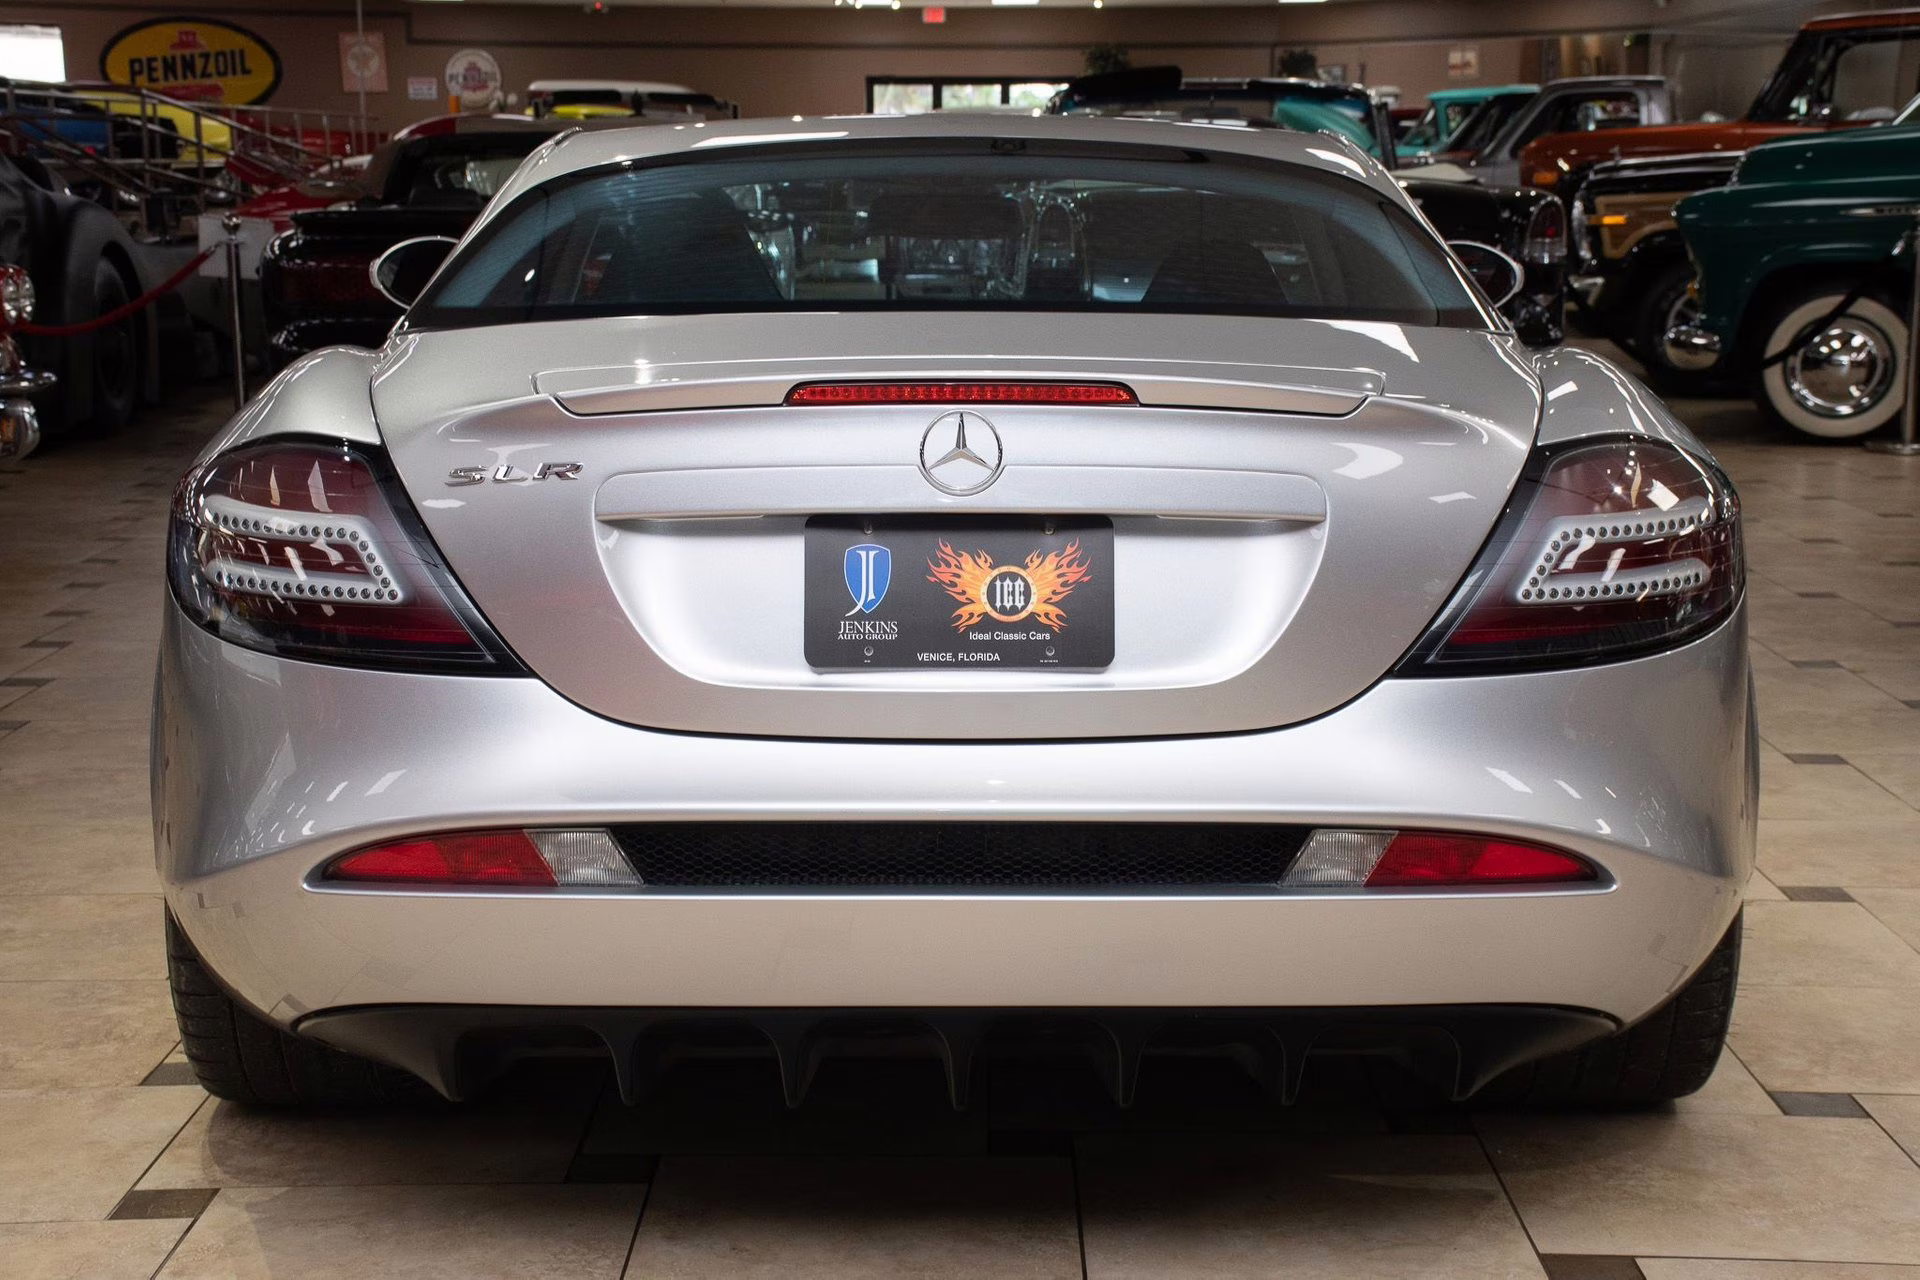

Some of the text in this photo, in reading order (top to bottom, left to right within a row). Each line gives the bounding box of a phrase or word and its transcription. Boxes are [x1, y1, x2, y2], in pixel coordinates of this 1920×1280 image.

[129, 48, 252, 84] PENNZOIL
[445, 461, 584, 487] SLR
[838, 620, 898, 634] JENKINS
[969, 631, 1051, 640] Ideal Classic Cars
[917, 652, 1000, 662] VENICE, FLORIDA
